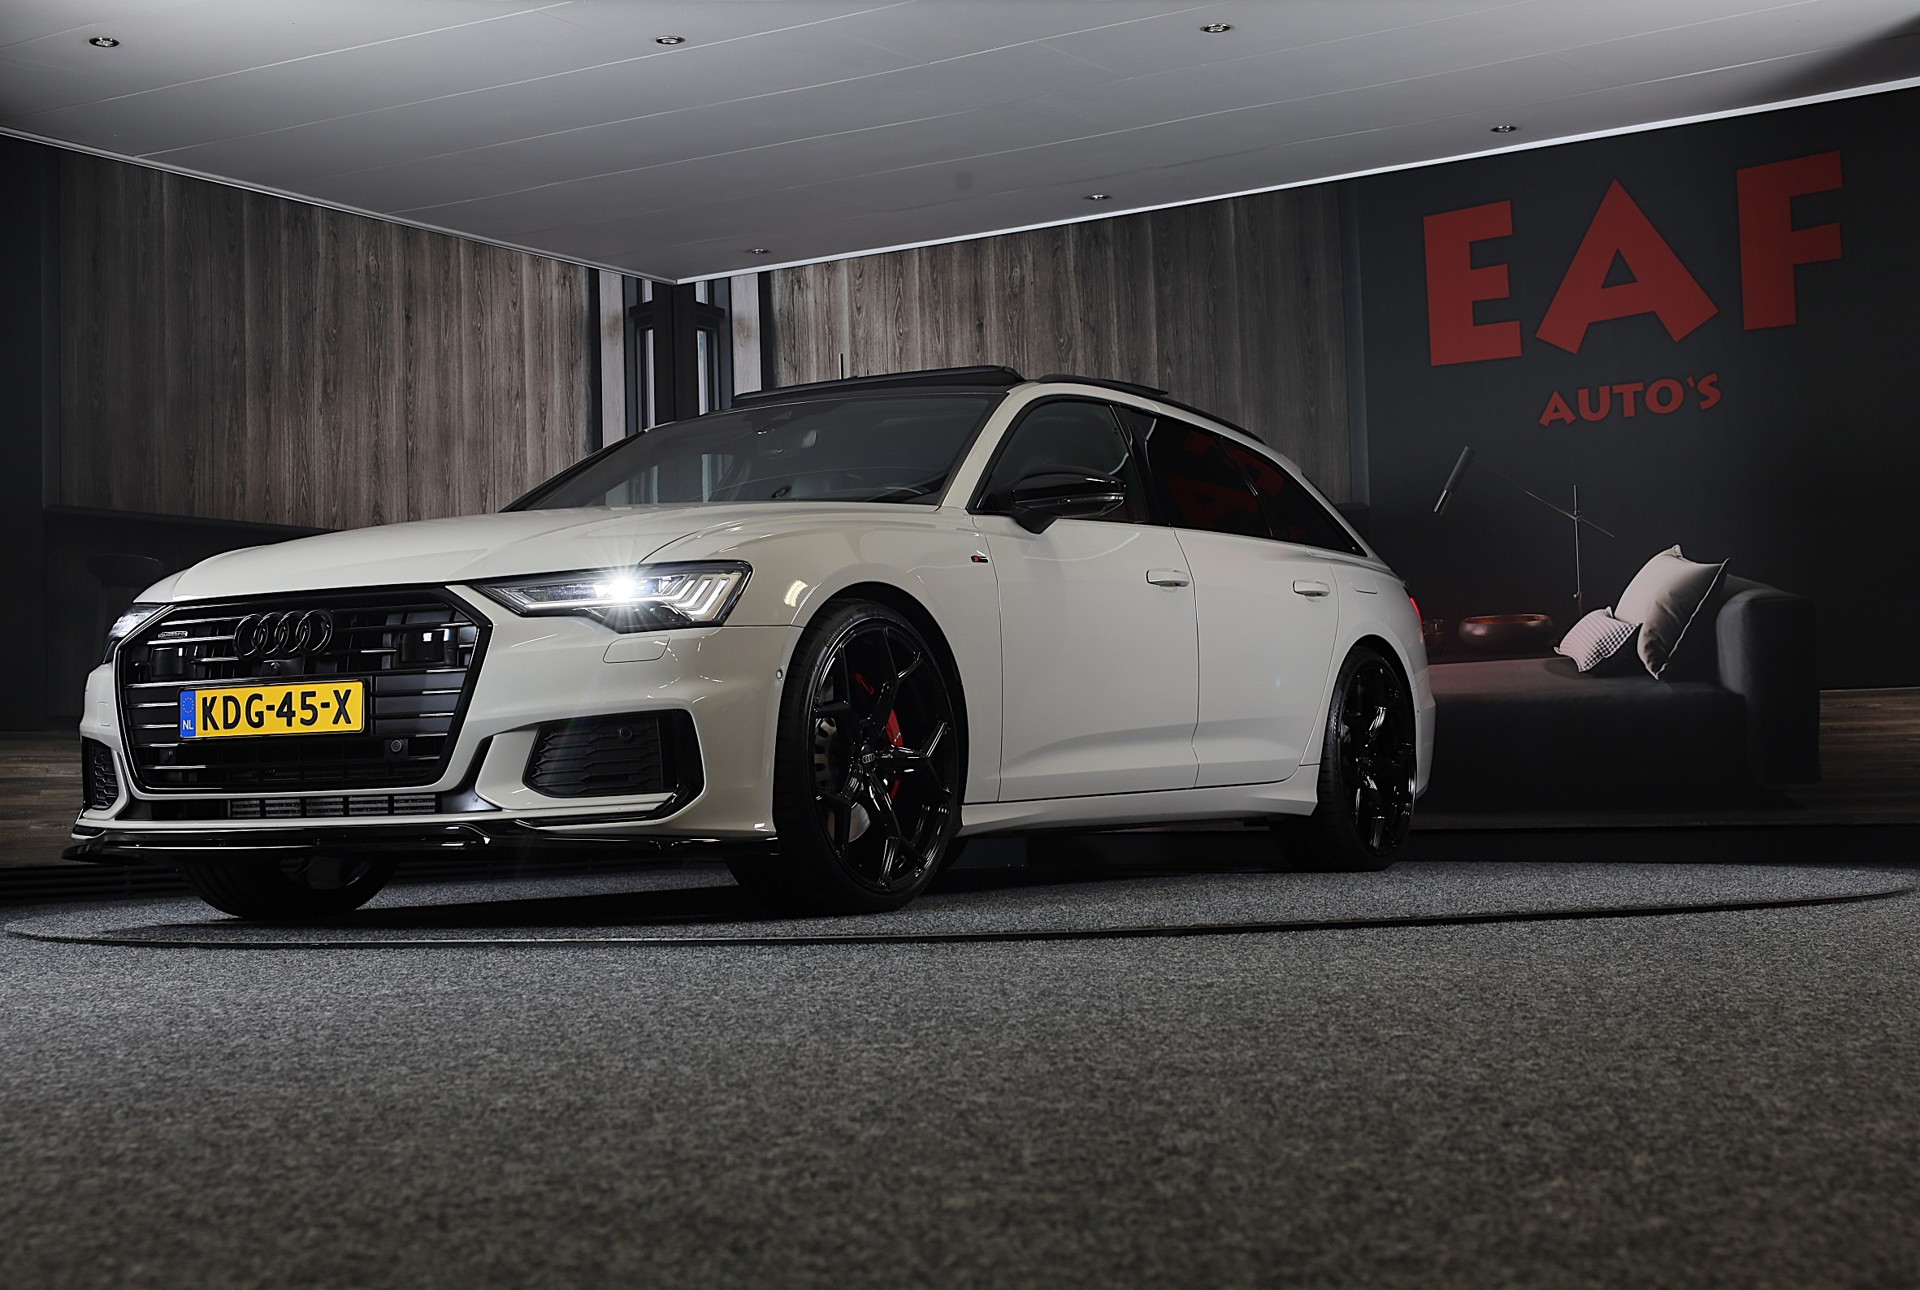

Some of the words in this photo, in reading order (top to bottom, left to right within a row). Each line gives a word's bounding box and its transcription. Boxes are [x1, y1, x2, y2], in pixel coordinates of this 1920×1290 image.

[1423, 151, 1843, 366] EAF
[1539, 373, 1722, 426] AUTO'S
[182, 719, 194, 731] NL
[202, 689, 352, 731] KDG-45-X
